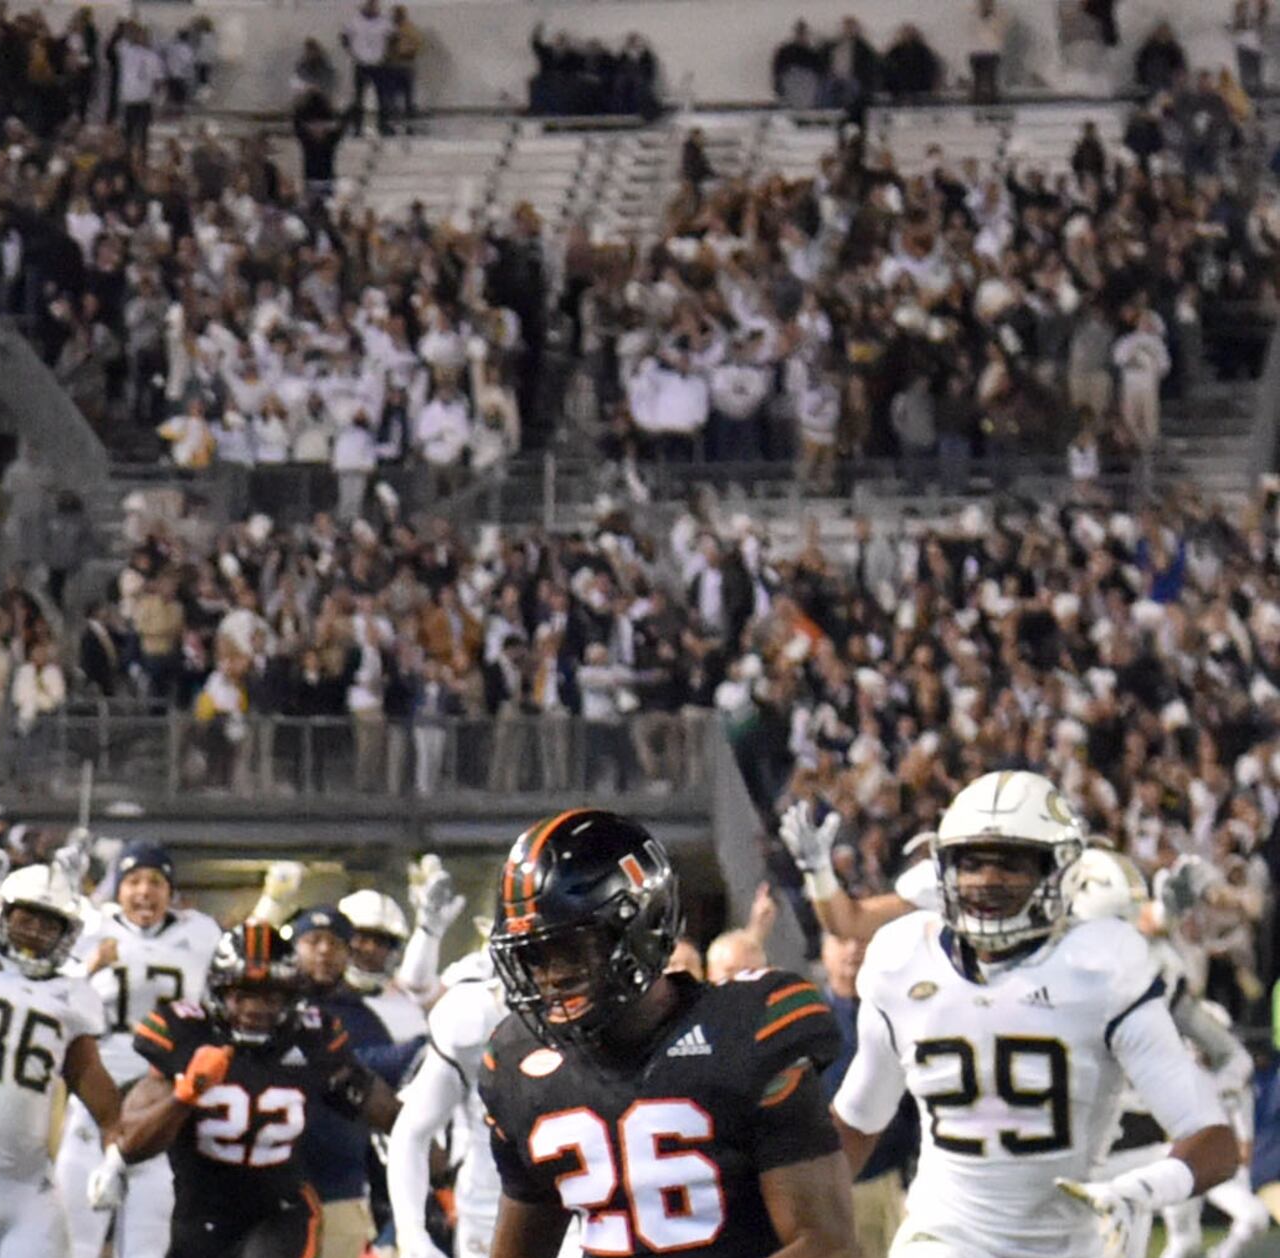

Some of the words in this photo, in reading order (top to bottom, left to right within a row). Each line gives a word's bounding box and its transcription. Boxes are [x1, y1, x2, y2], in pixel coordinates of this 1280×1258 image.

[196, 1082, 307, 1168] 22
[913, 1035, 1073, 1158] 29
[528, 1097, 727, 1257] 26
